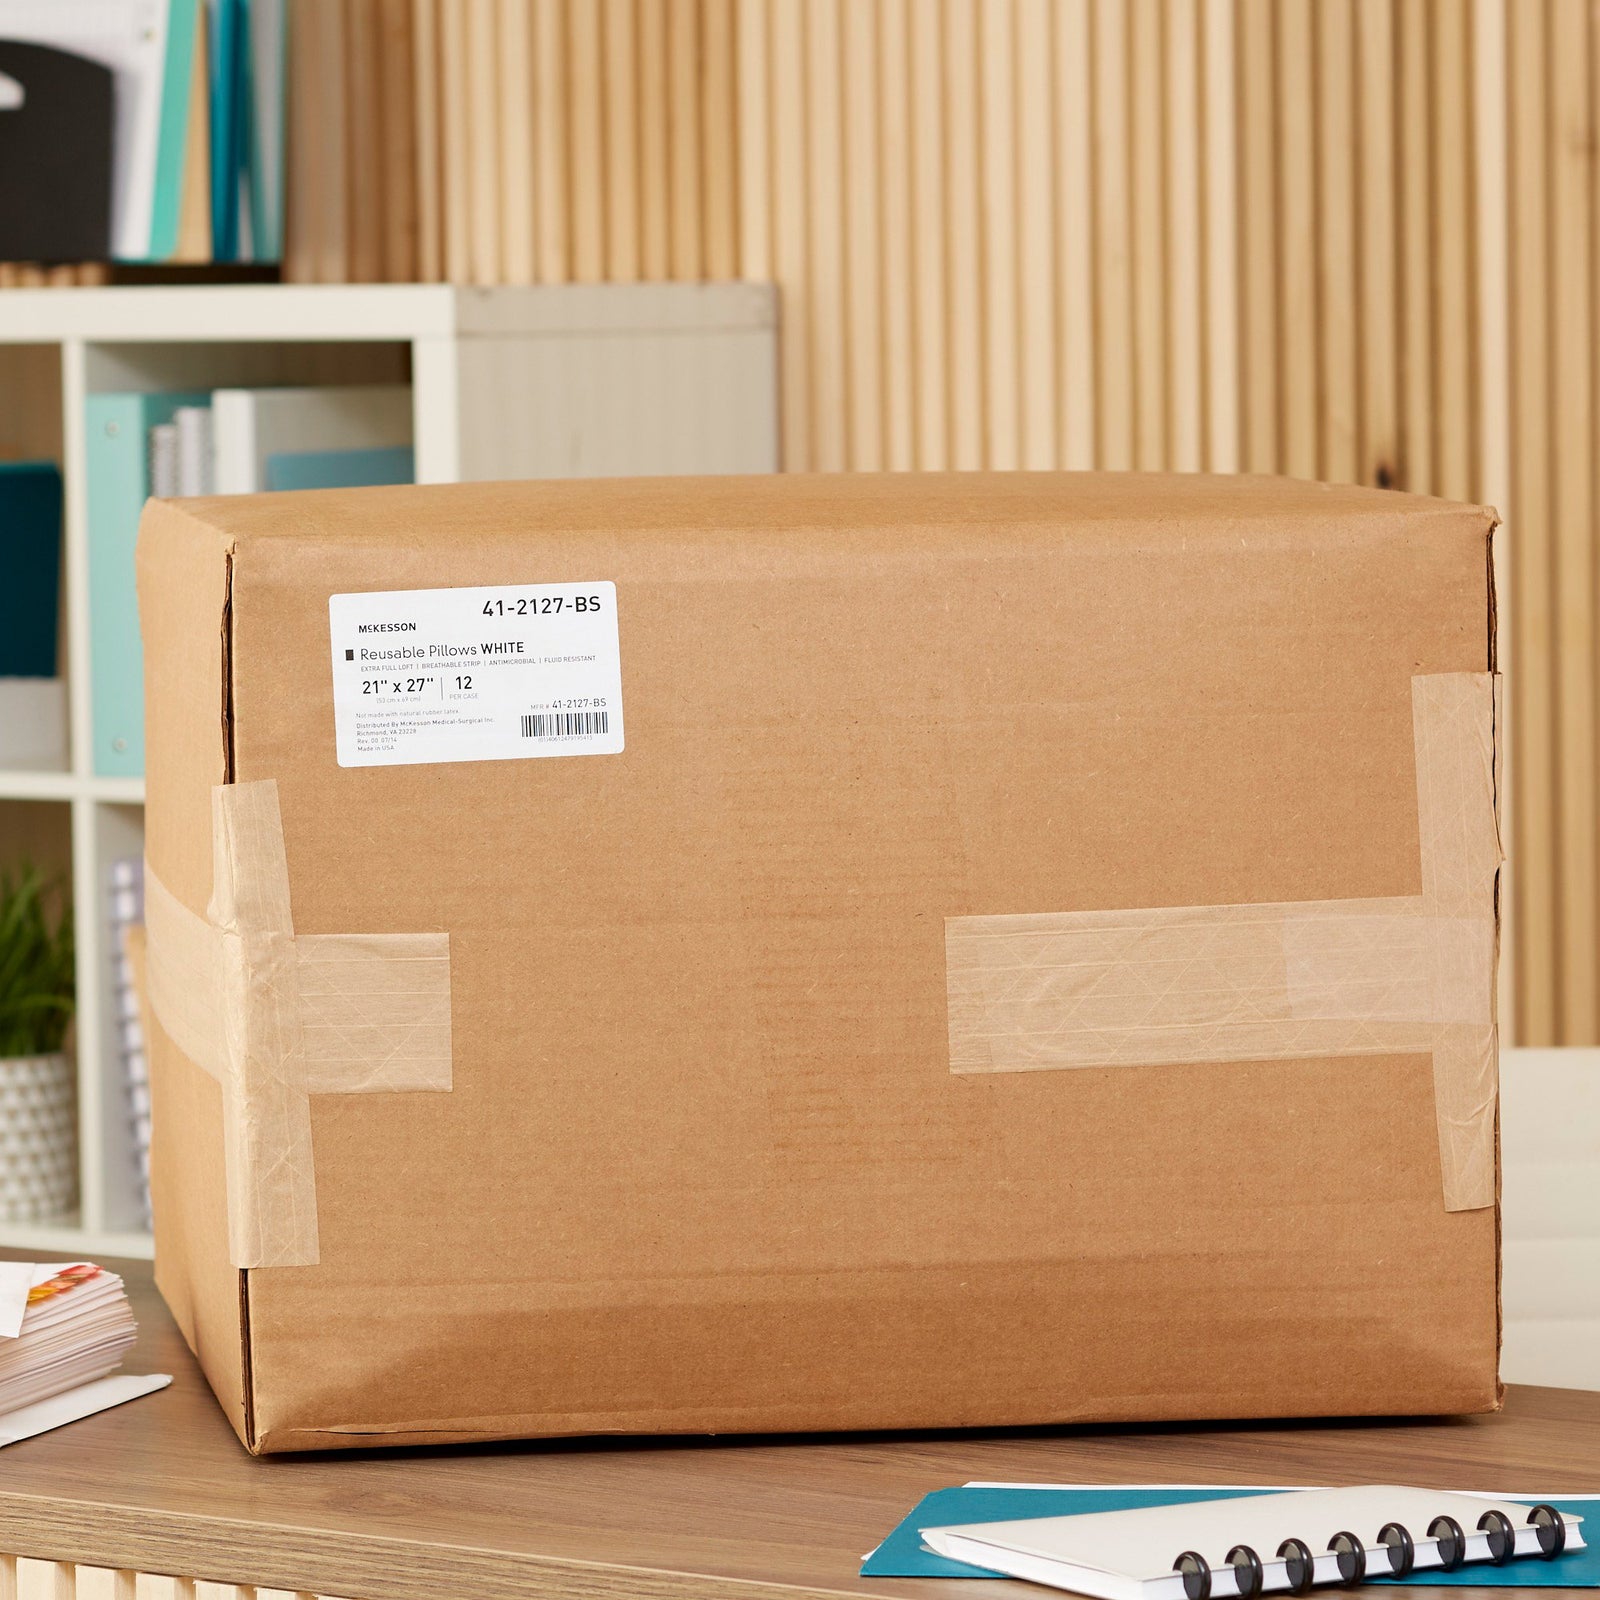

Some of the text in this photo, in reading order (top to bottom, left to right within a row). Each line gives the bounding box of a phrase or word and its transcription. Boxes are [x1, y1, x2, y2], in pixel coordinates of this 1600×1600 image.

[482, 596, 601, 616] 41-2127-BS
[360, 641, 524, 661] Reusable Pillows WHITE
[361, 665, 380, 673] EXTRA
[399, 663, 413, 671] LOFT
[421, 661, 461, 670] BREATHABLE
[463, 660, 481, 668] STRIP
[488, 658, 536, 666] ANTIMICROBIAL
[544, 656, 562, 664] FLUID
[563, 655, 596, 663] RESISTANT
[362, 677, 434, 695] 21" x 27"
[455, 675, 472, 690] 12
[552, 698, 607, 709] 41-2127-BS
[356, 721, 390, 729] Distributed
[432, 717, 483, 726] Medical-Surgical
